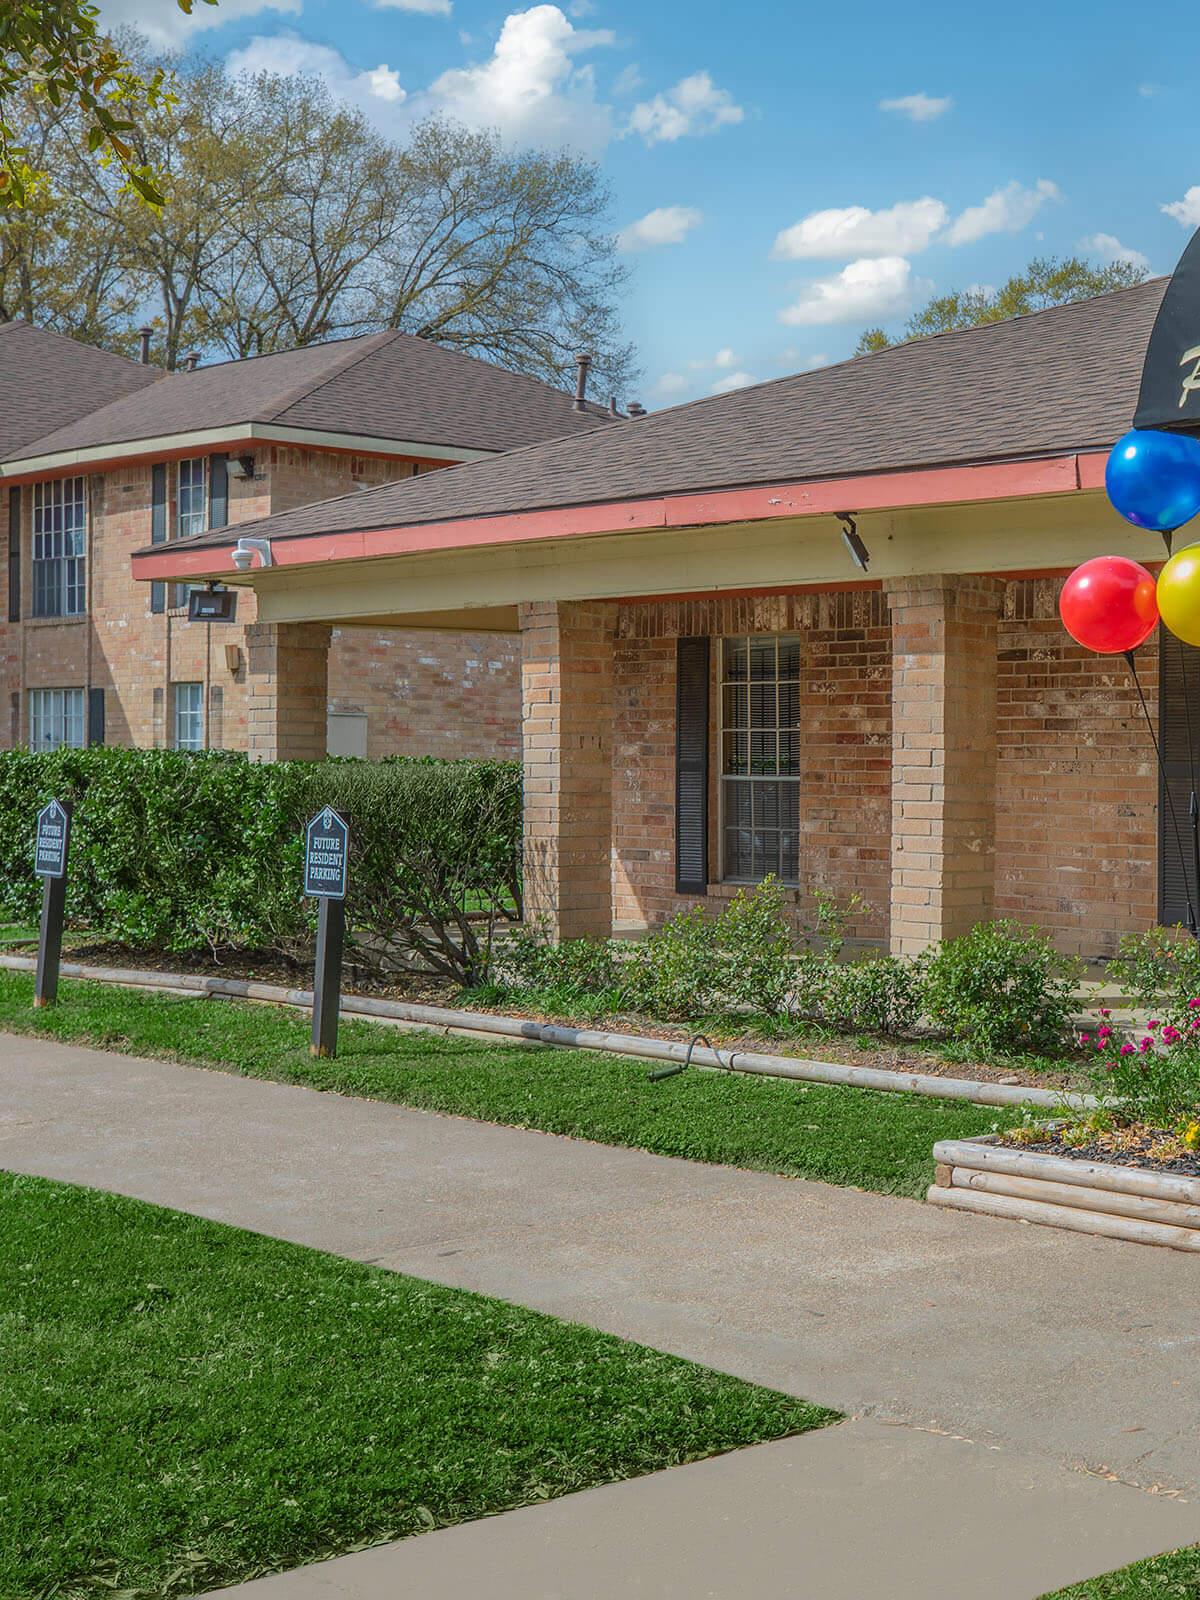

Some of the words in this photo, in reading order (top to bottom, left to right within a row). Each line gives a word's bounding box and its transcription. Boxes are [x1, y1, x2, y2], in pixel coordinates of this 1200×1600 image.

[41, 824, 61, 837] FUTURE
[39, 838, 62, 849] RESIDENT
[313, 838, 340, 850] FUTURE
[38, 849, 61, 863] PARKING
[309, 852, 343, 867] RESIDENT
[310, 868, 341, 881] PARKING
